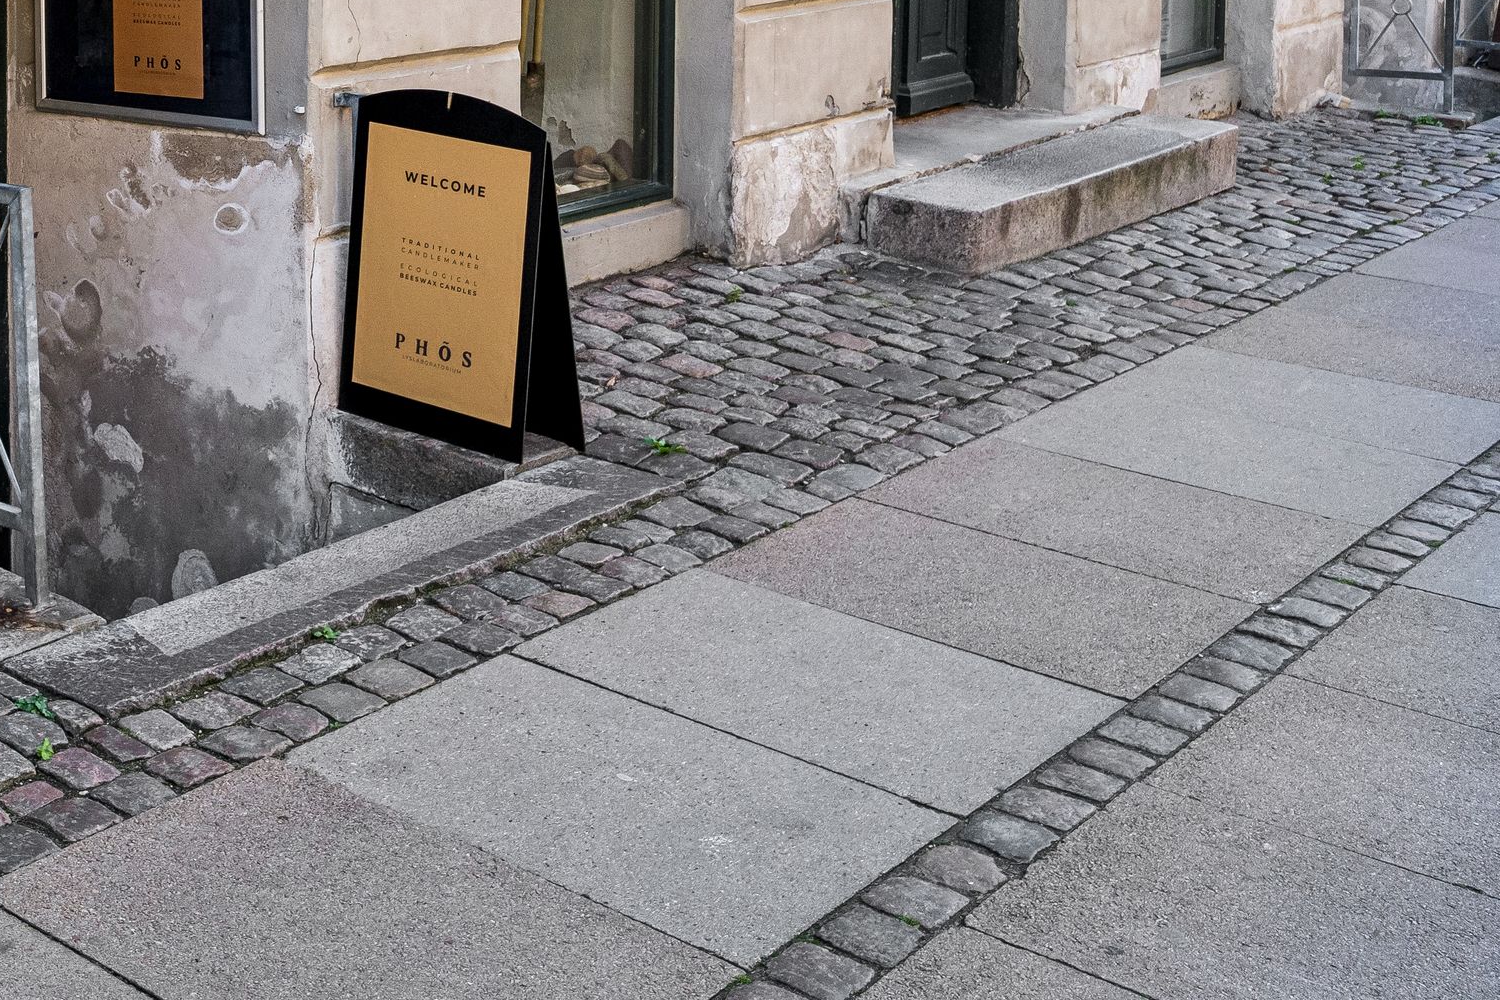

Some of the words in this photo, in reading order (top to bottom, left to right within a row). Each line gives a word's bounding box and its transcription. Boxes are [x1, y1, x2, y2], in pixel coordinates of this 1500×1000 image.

[405, 171, 486, 197] WELCOME
[401, 247, 479, 270] CANDLEMAKER
[402, 238, 479, 260] TRADITIONAL
[400, 263, 477, 287] ECOLOGICAL
[400, 272, 437, 287] BEESWAX
[439, 282, 477, 296] CANDLES
